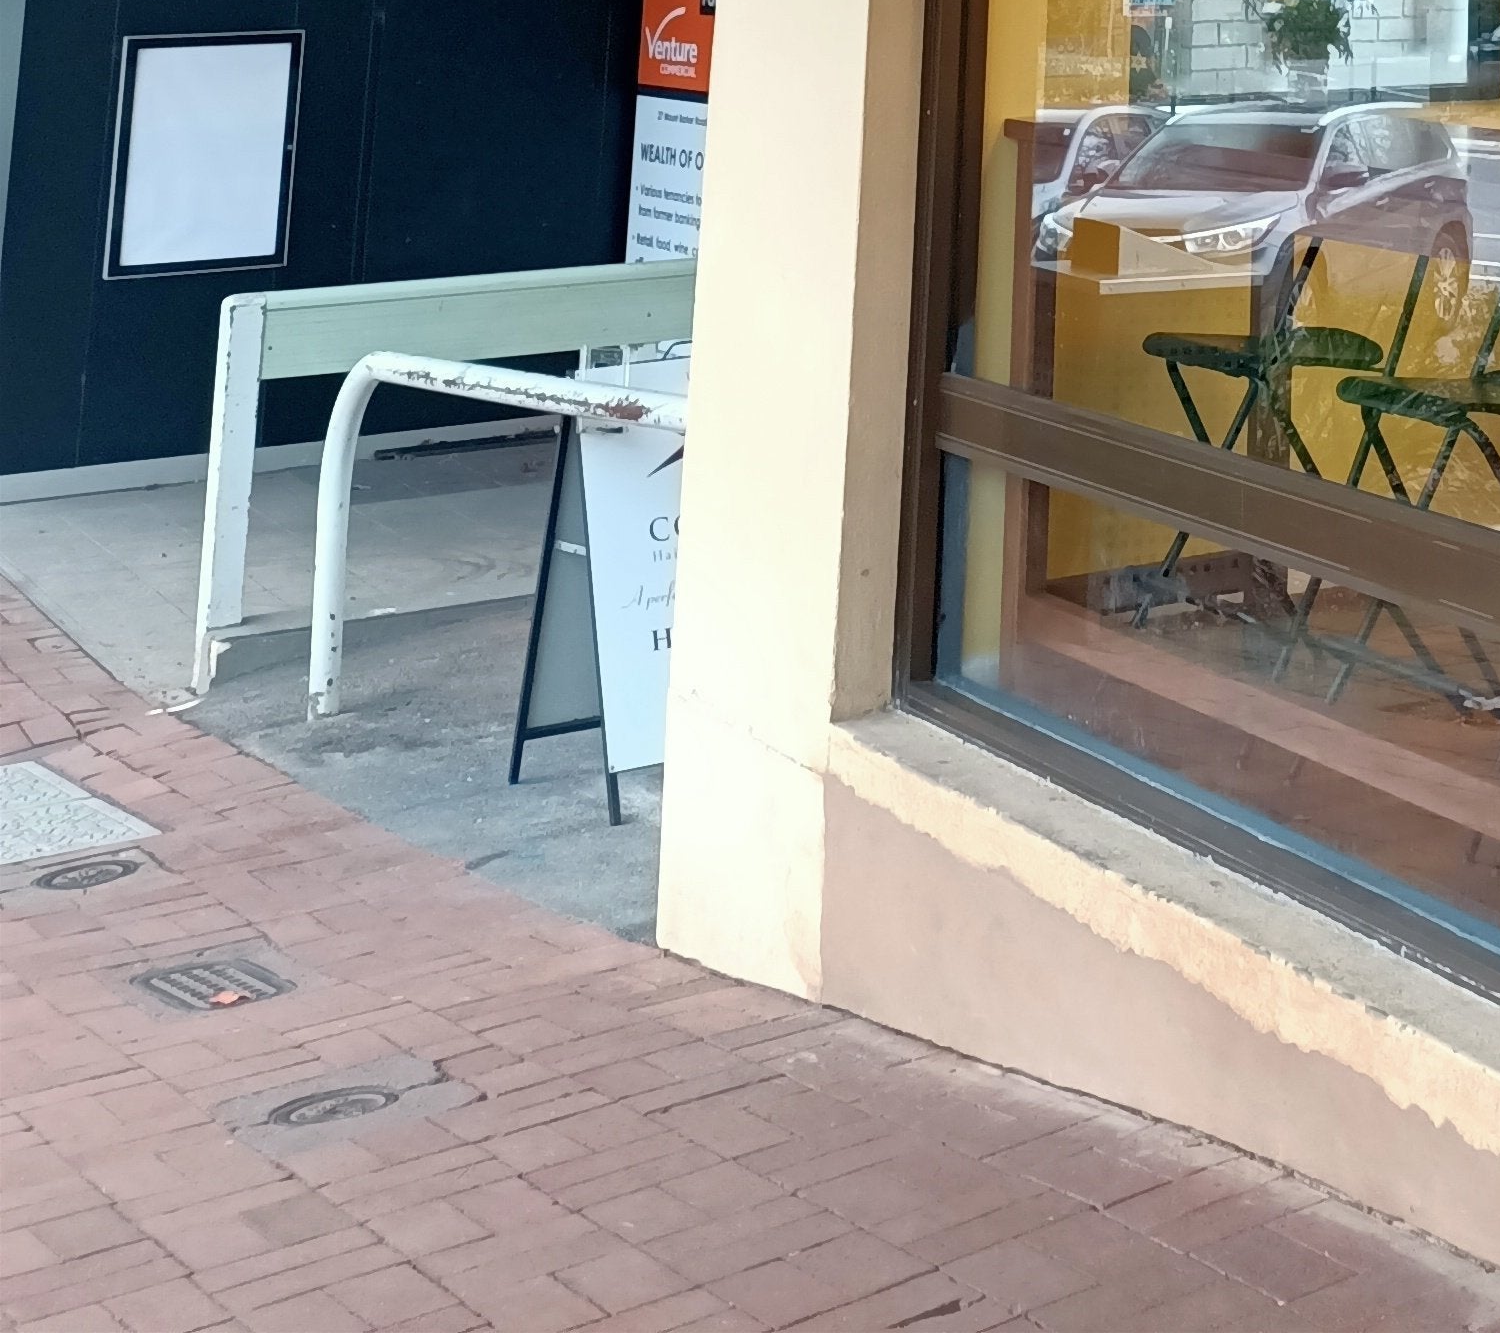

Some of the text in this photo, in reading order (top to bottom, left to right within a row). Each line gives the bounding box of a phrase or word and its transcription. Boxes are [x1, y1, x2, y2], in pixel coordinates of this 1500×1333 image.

[645, 6, 698, 64] Venture
[641, 142, 677, 167] WEALTH
[679, 149, 693, 169] OF
